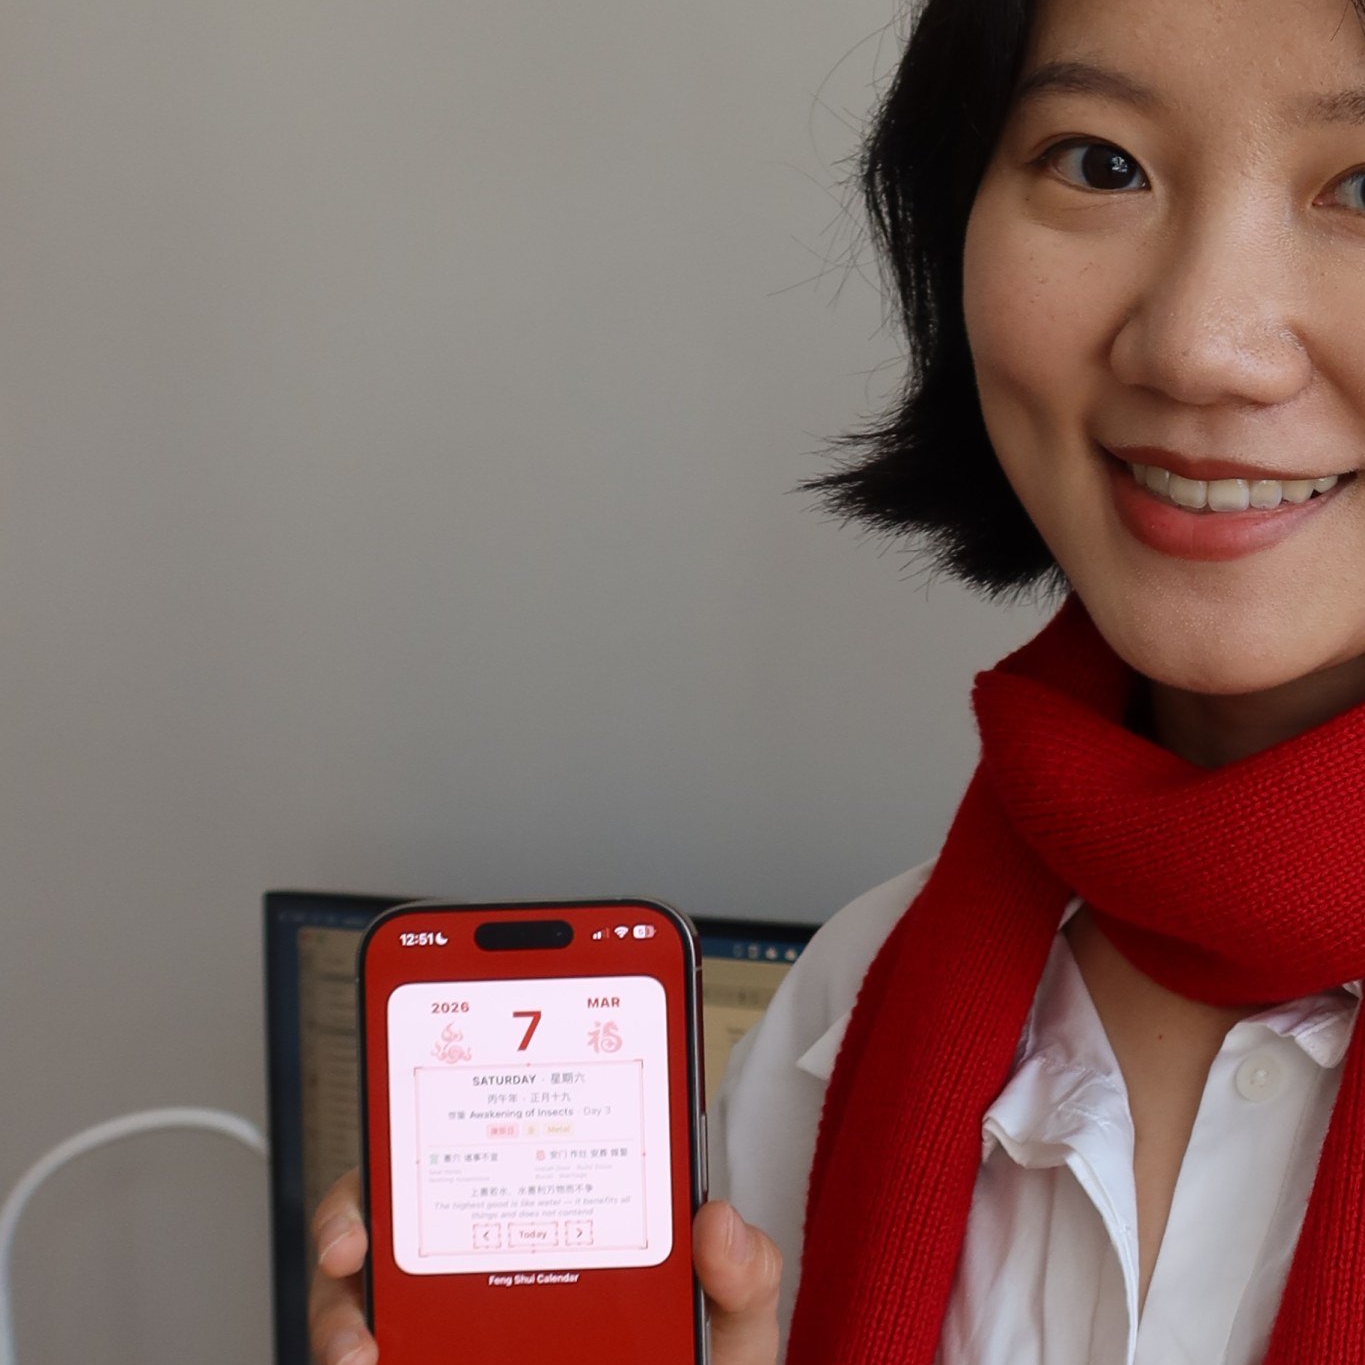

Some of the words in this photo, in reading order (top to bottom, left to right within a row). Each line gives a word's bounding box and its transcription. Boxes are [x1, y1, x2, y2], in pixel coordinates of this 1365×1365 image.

[399, 932, 435, 946] 12:51
[431, 1002, 470, 1014] 2026
[513, 1010, 542, 1052] 7
[587, 997, 620, 1009] MAR
[472, 1074, 537, 1087] SATURDAY
[550, 1072, 586, 1084] 星期六
[530, 1091, 571, 1103] 正月十九
[469, 1109, 522, 1120] Awakening
[525, 1108, 535, 1117] of
[537, 1107, 574, 1117] Insects
[583, 1105, 602, 1118] Day
[519, 1230, 547, 1240] Today
[488, 1275, 513, 1286] Feng
[514, 1274, 535, 1285] Shui
[537, 1272, 580, 1284] Calendar
